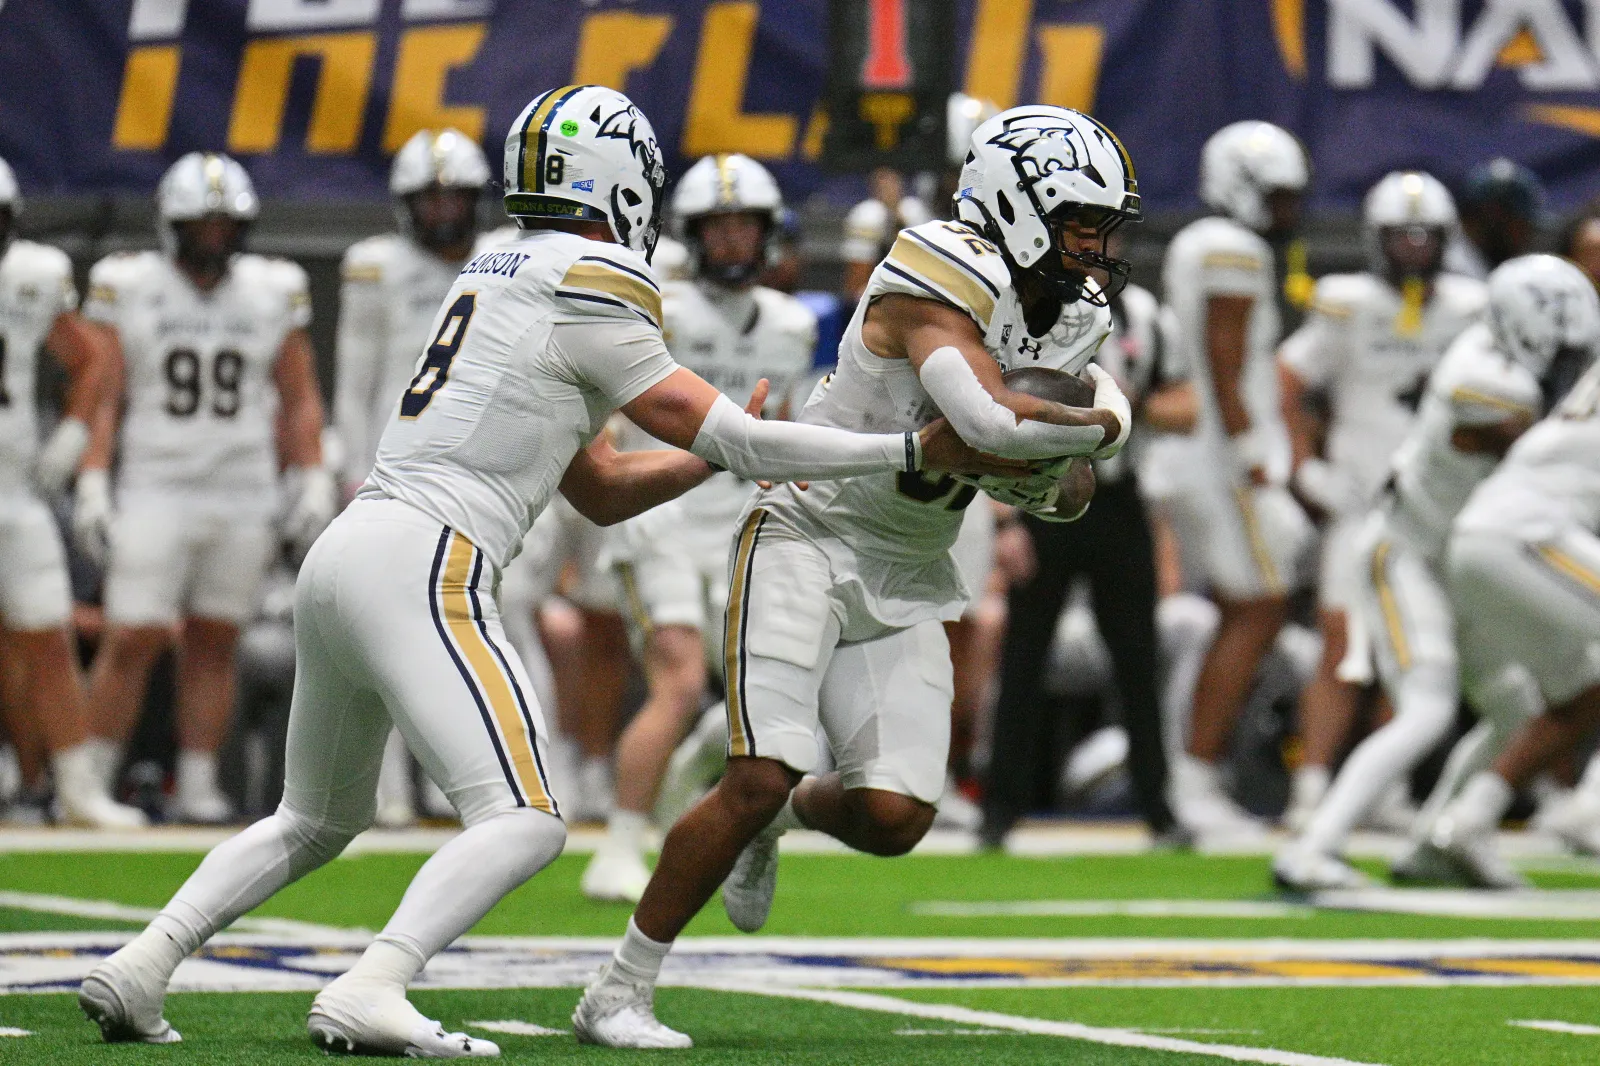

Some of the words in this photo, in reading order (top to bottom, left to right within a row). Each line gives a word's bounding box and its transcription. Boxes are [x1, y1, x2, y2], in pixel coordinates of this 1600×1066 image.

[1326, 0, 1600, 91] NA
[561, 123, 578, 133] C2P
[546, 154, 564, 185] 8
[546, 203, 584, 217] STATE
[398, 290, 479, 421] 8
[163, 347, 245, 419] 99
